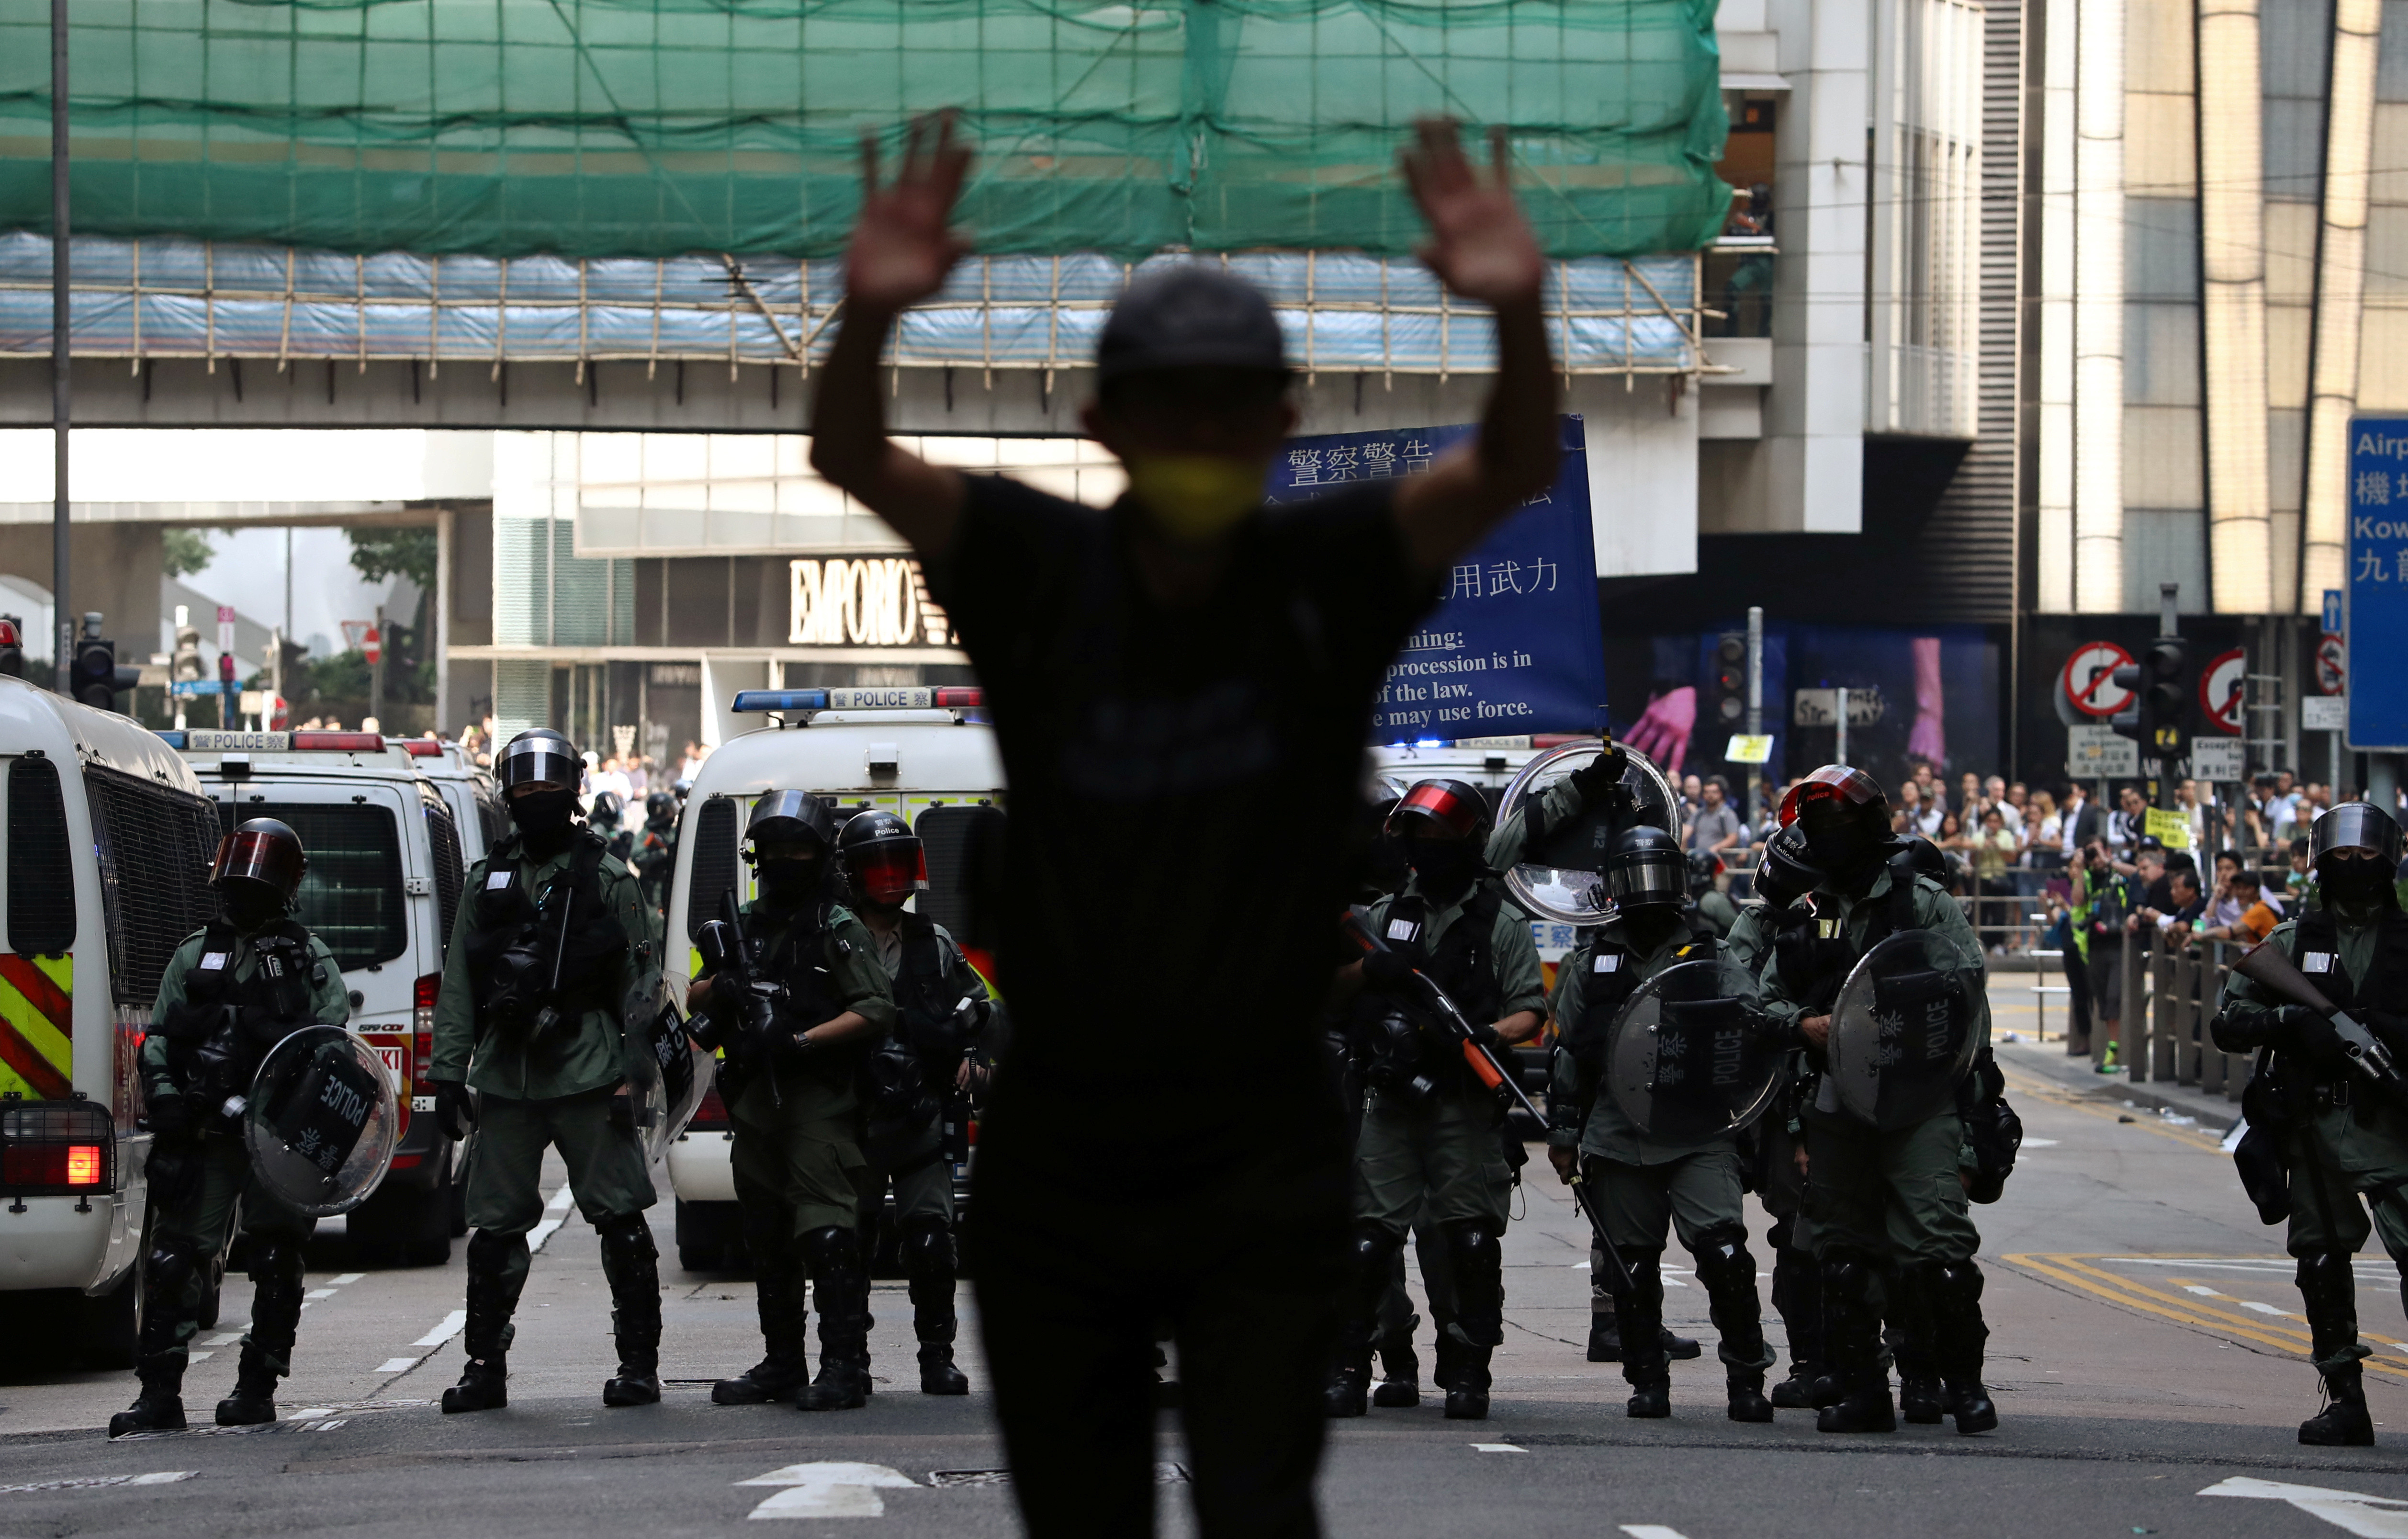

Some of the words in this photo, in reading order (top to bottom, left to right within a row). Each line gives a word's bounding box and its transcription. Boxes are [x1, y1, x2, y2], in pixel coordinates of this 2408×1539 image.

[1288, 439, 1433, 485] 警察警告
[1438, 557, 1557, 600] 用武力
[1408, 629, 1463, 650] ning:
[1386, 655, 1487, 682] procession
[1492, 652, 1508, 669] is
[1512, 650, 1532, 668] in
[834, 693, 846, 706] 警
[854, 691, 907, 706] POLICE
[914, 691, 928, 705] 察
[1395, 684, 1427, 702] the
[1432, 681, 1473, 699] law.
[1389, 709, 1432, 728] may
[1438, 705, 1471, 722] use
[1476, 700, 1533, 719] force.
[193, 735, 211, 747] 警
[214, 735, 263, 748] POLICE
[266, 735, 285, 748] 察
[1807, 792, 1830, 803] Police
[875, 827, 900, 837] Police
[1551, 926, 1573, 948] 察
[1879, 1009, 1904, 1066] 警察
[1926, 998, 1948, 1059] POLICE
[1657, 1031, 1688, 1085] 警察
[1712, 1029, 1743, 1084] POLICE
[320, 1075, 368, 1127] POLICE
[295, 1127, 338, 1169] 警察
